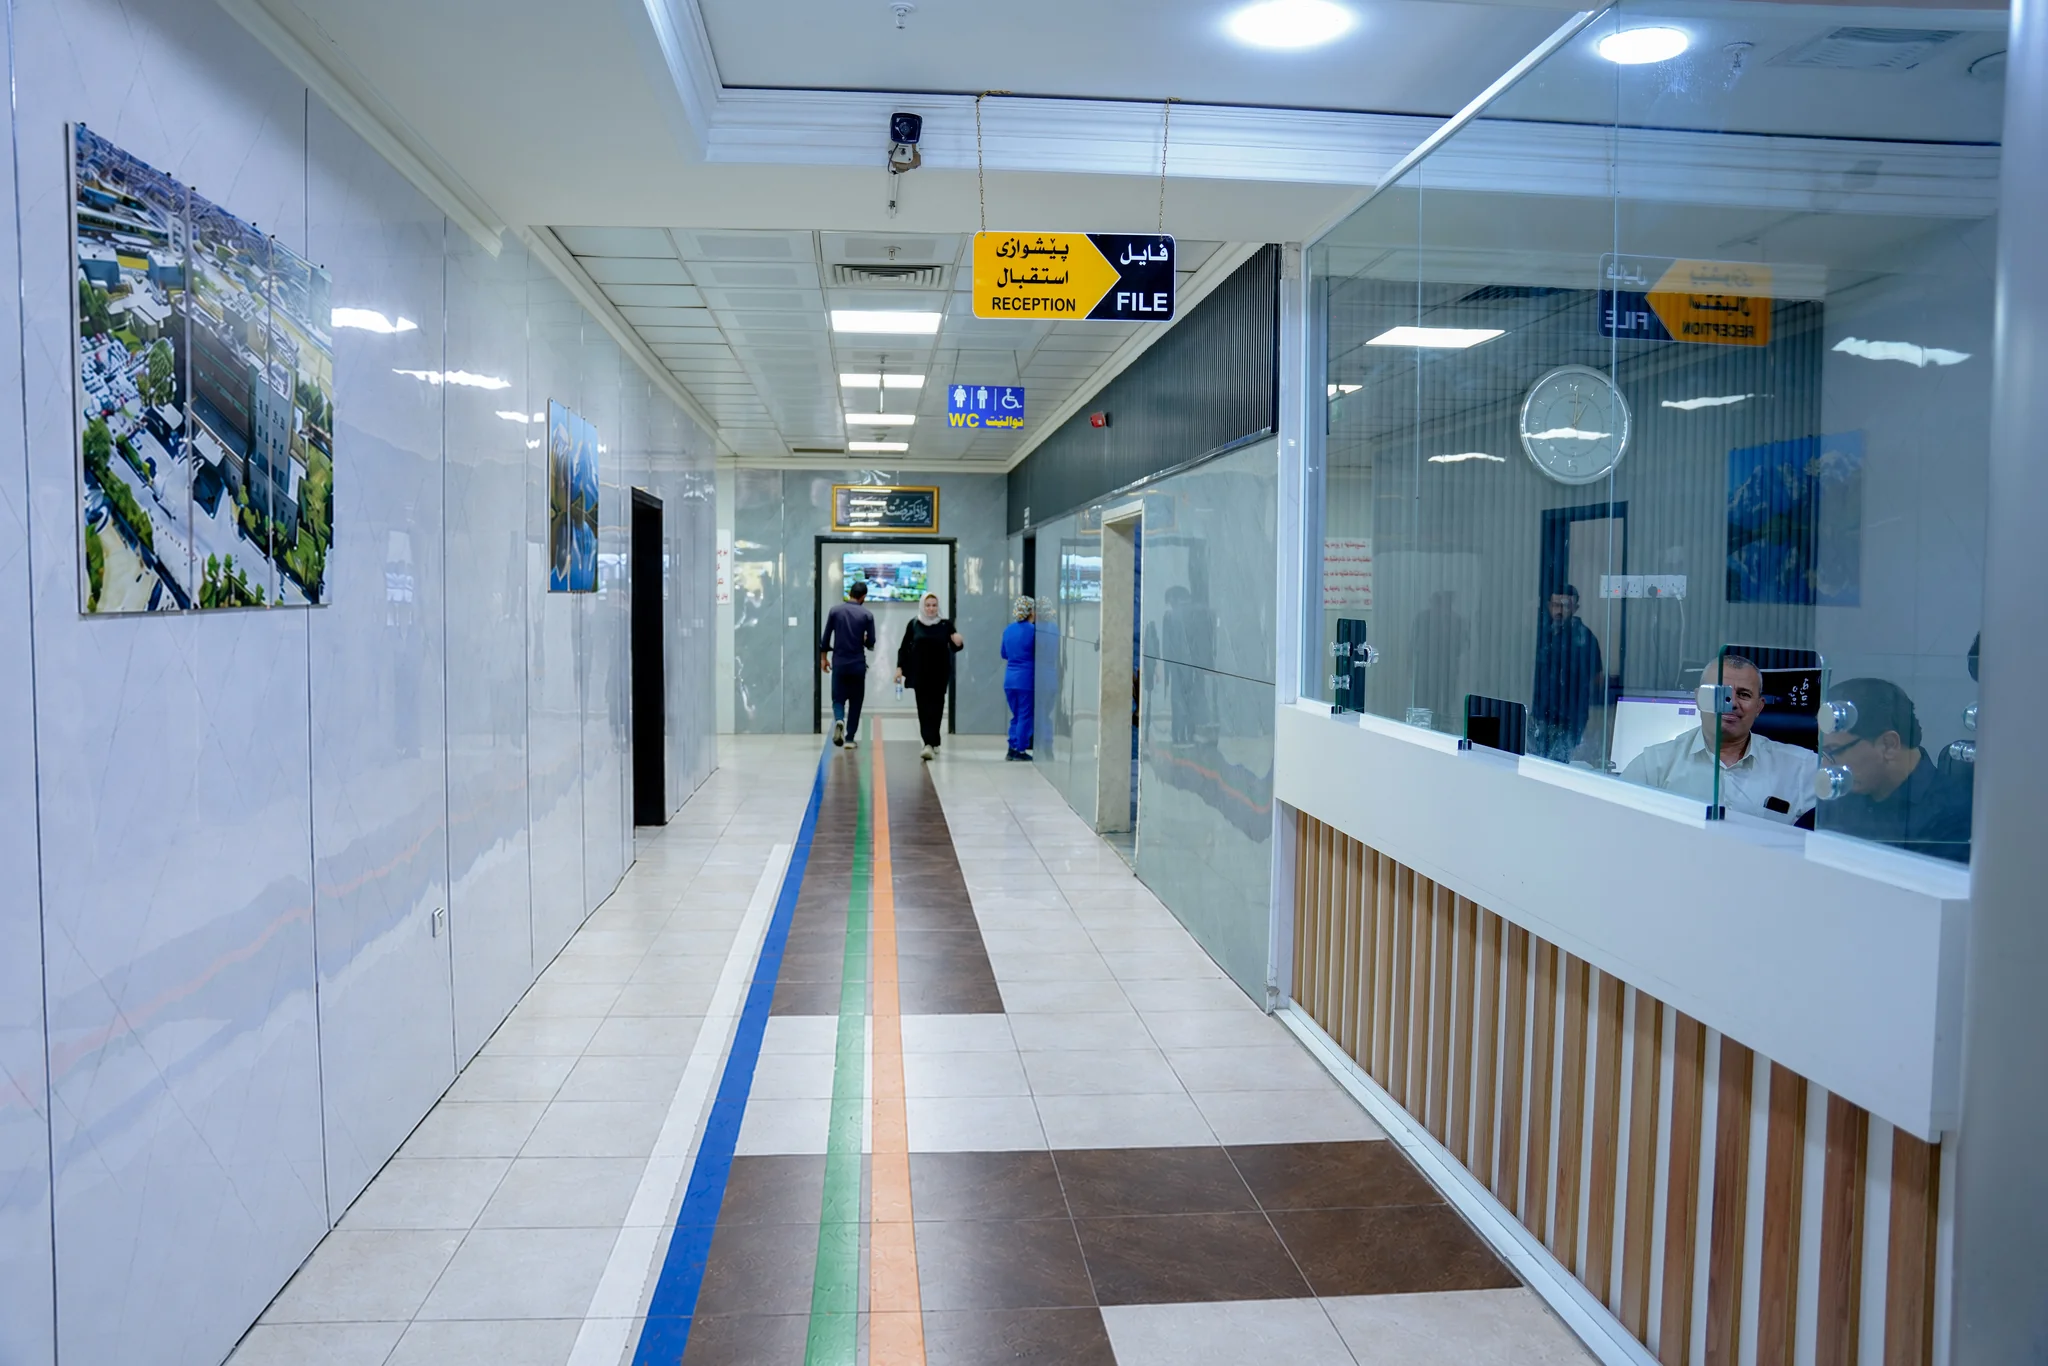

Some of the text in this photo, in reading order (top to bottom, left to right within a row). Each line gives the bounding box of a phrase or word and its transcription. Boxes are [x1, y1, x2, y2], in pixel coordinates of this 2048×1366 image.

[996, 267, 1069, 289] استقبال
[992, 297, 1076, 312] RECEPTION
[1117, 292, 1168, 312] FILE
[948, 412, 979, 428] WC
